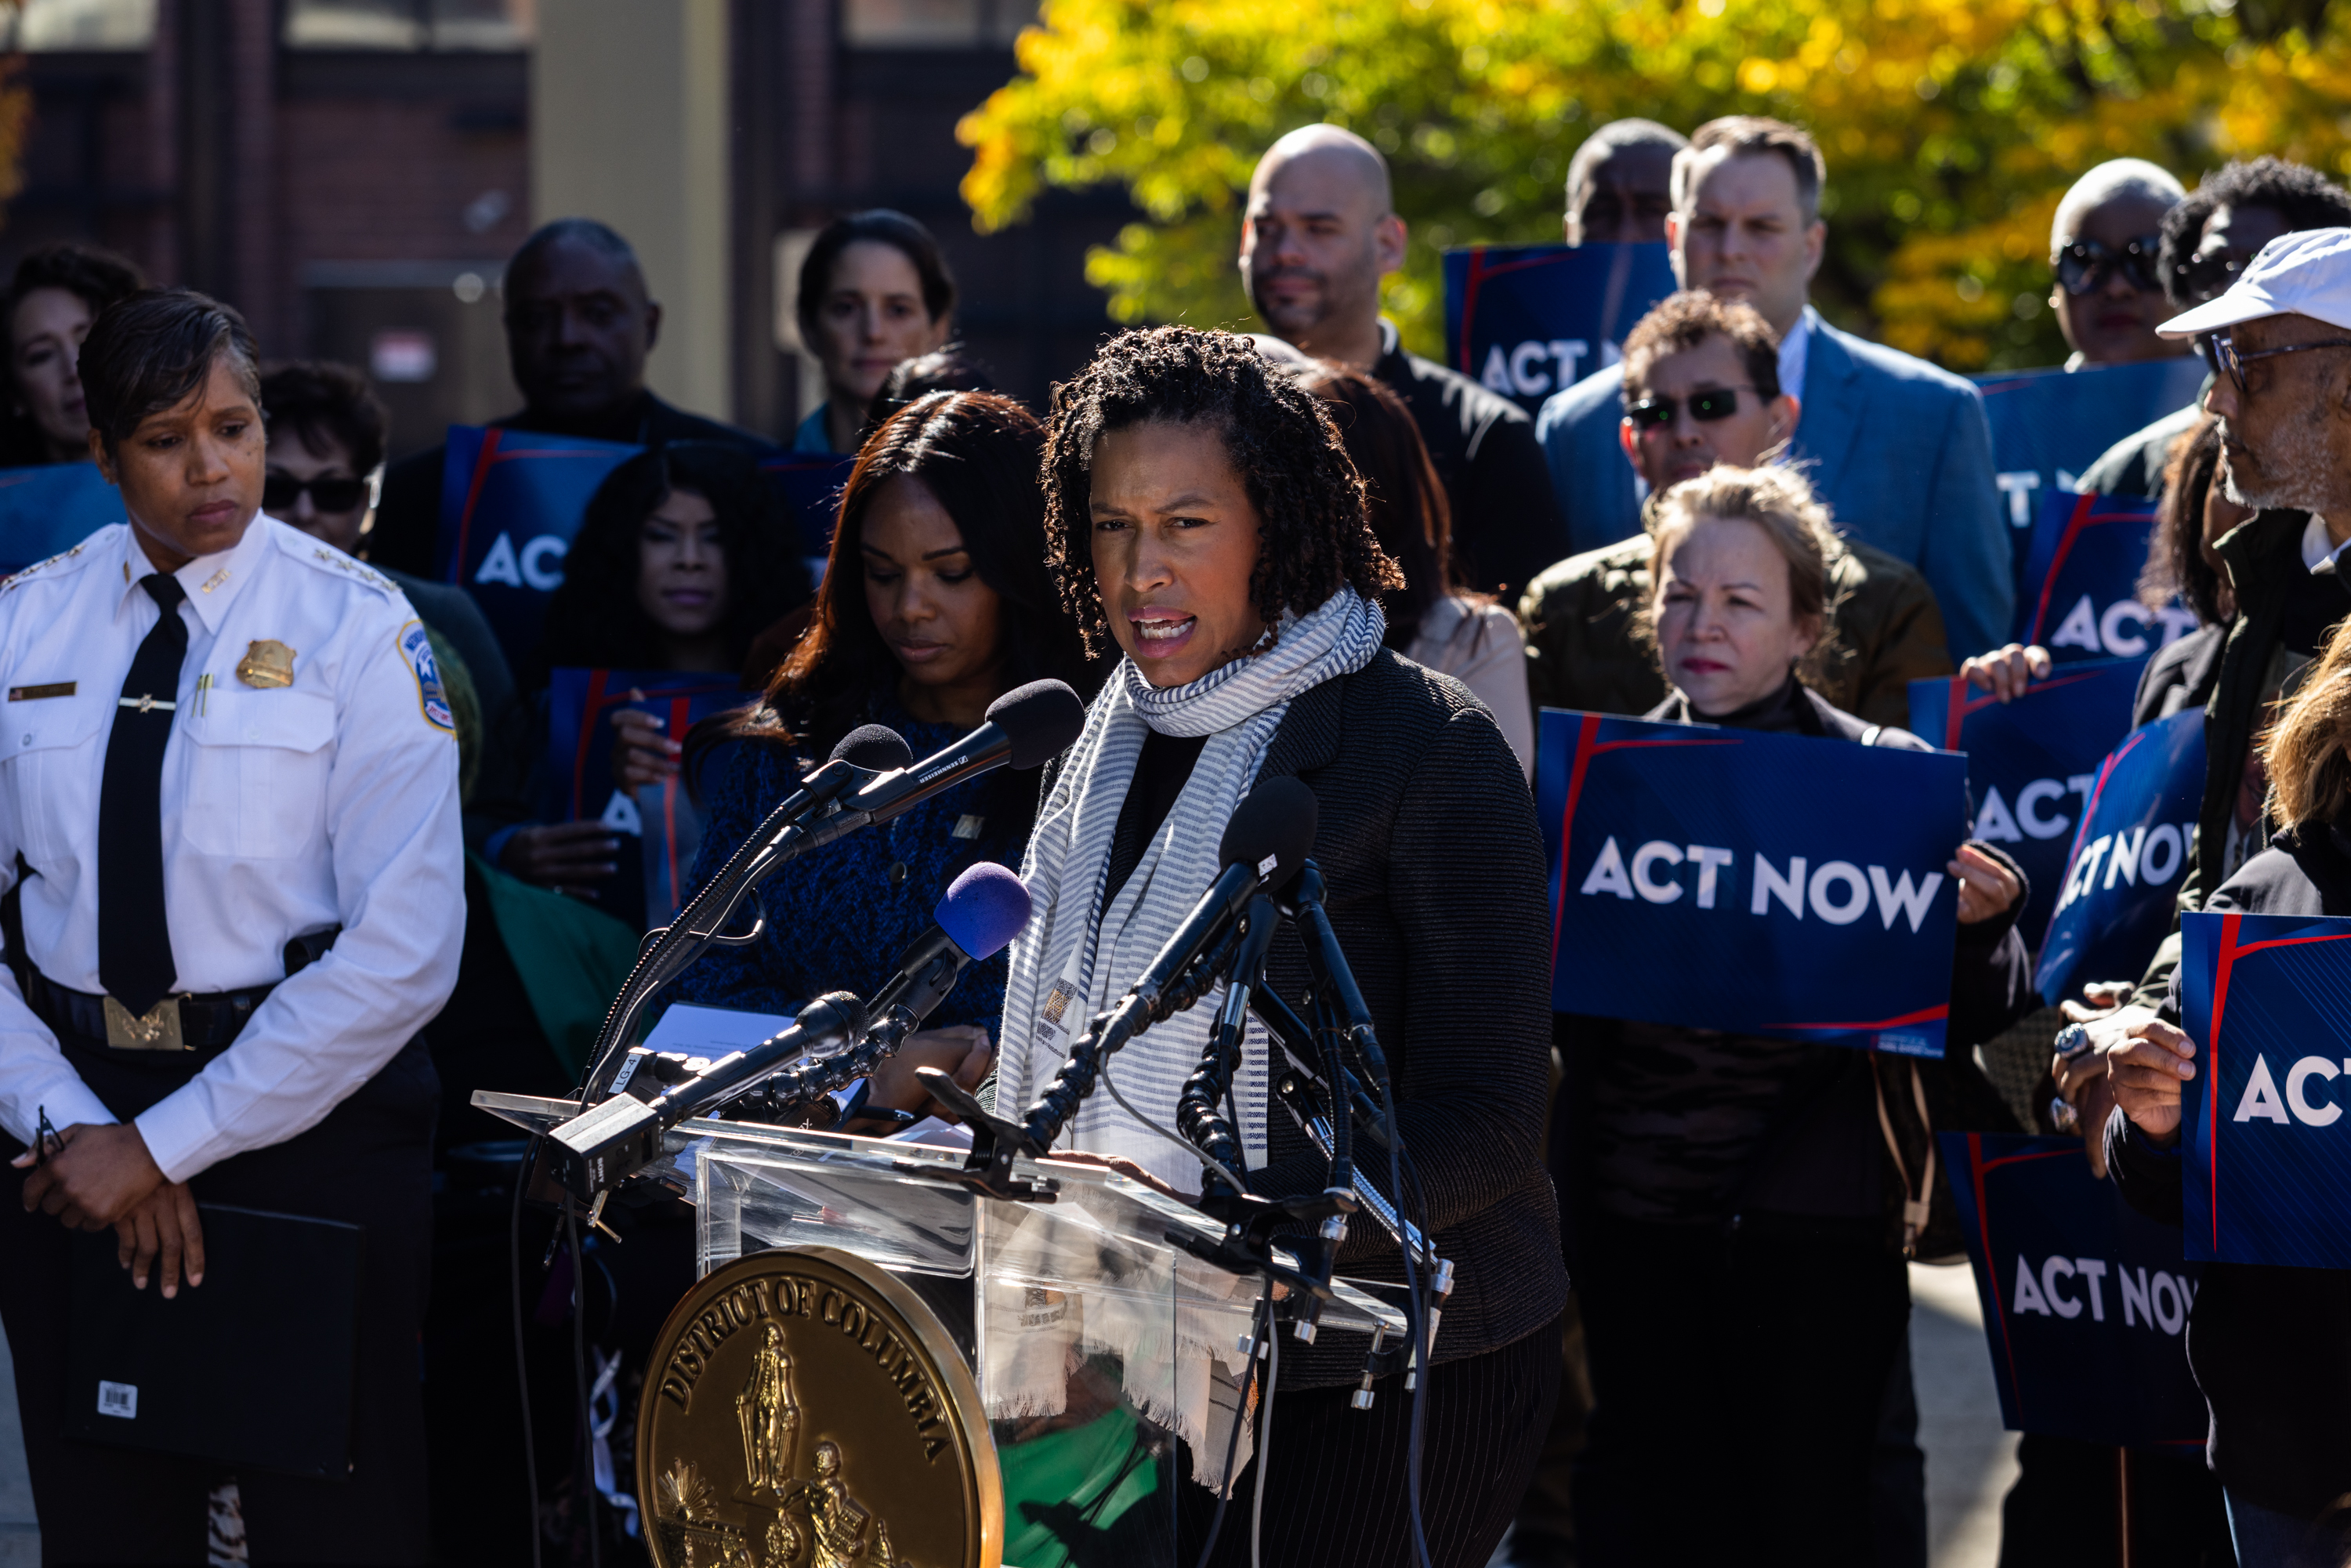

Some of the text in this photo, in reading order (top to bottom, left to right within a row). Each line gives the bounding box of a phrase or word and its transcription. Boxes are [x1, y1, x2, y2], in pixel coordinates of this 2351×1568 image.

[1481, 339, 1588, 397] ACT
[475, 531, 567, 591] AC
[919, 760, 958, 784] SENNHEISER
[1581, 835, 1944, 934] ACT NOW
[2103, 823, 2194, 890] NO
[615, 1059, 637, 1085] LG-4
[2233, 1052, 2351, 1127] AC
[2013, 1253, 2106, 1322] ACT
[661, 1276, 951, 1463] DISTRICT OF COLUMBIA
